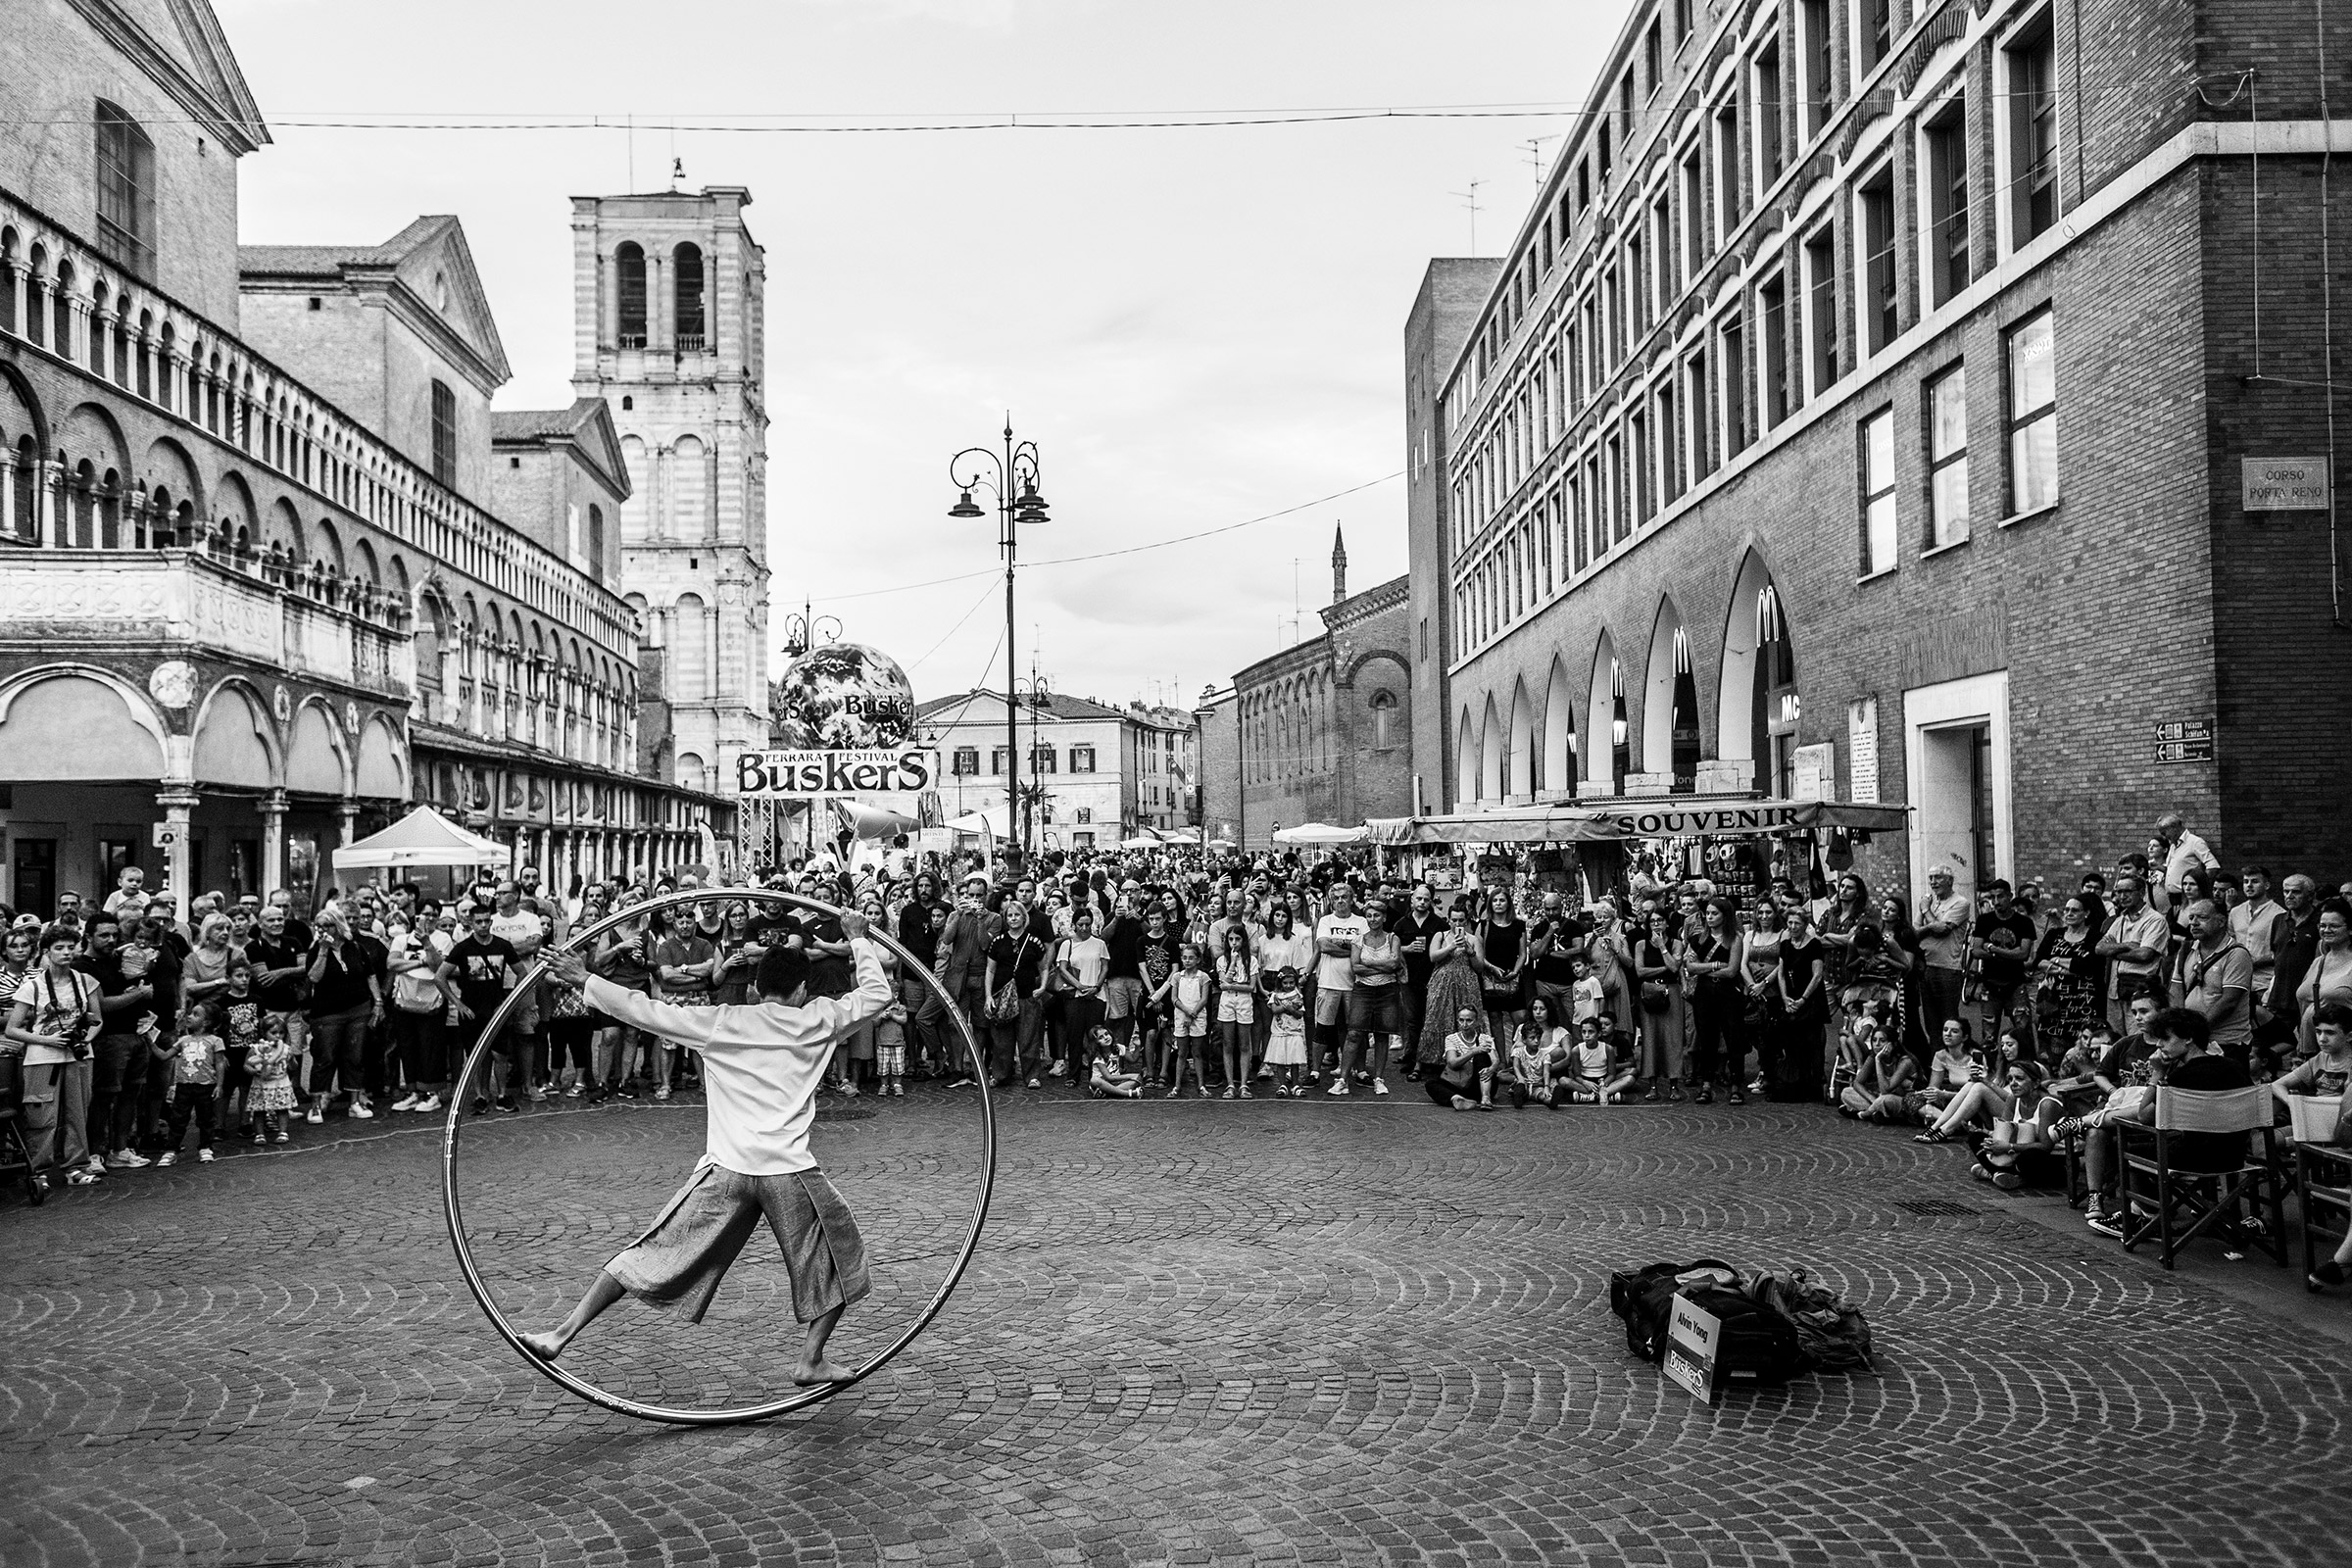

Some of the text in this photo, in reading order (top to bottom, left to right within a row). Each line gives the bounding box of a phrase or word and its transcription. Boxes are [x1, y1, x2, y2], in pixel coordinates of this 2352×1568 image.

[2266, 470, 2305, 480] CORSO
[2249, 486, 2322, 498] PORTA RENO
[765, 753, 899, 762] FERRARA FESTIVAL
[1617, 808, 1800, 834] SOUVENIR
[1677, 1311, 1708, 1344] Alvin Yong
